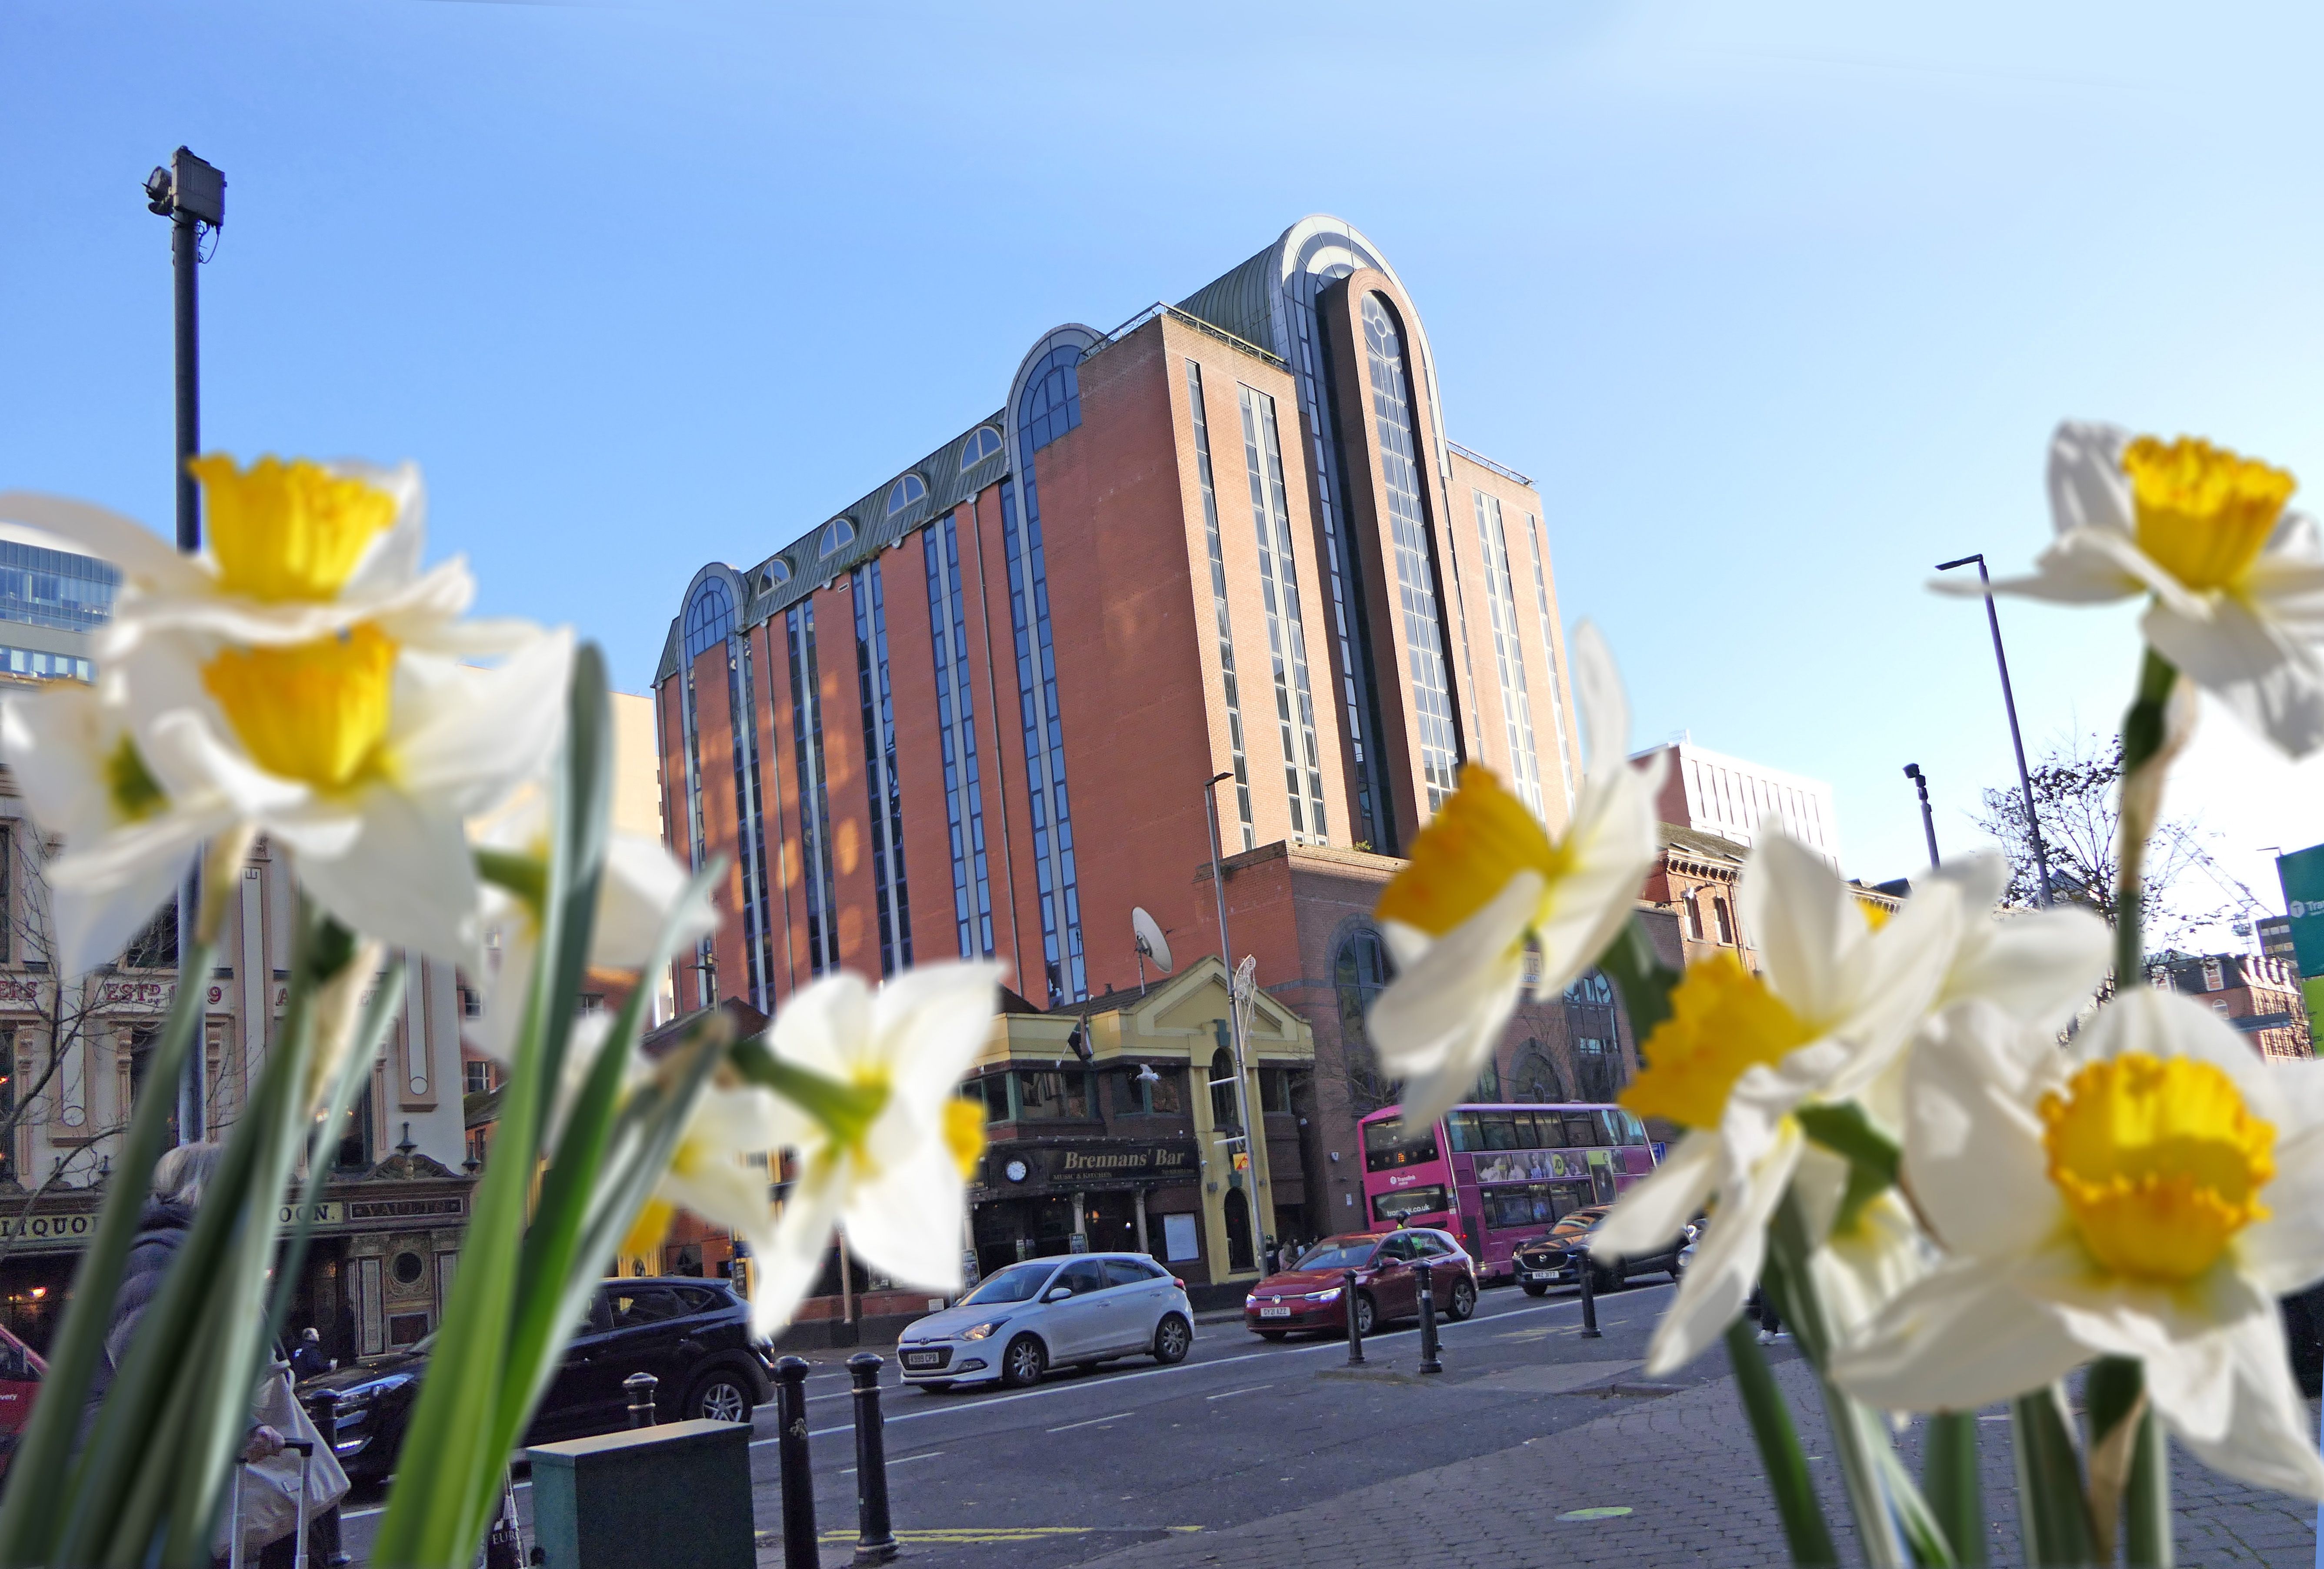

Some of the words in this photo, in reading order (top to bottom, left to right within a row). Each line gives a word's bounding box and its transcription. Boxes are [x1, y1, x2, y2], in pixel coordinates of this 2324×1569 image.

[2305, 901, 2324, 911] Tra
[1064, 1148, 1151, 1169] Brennans'
[1155, 1149, 1185, 1166] Bar
